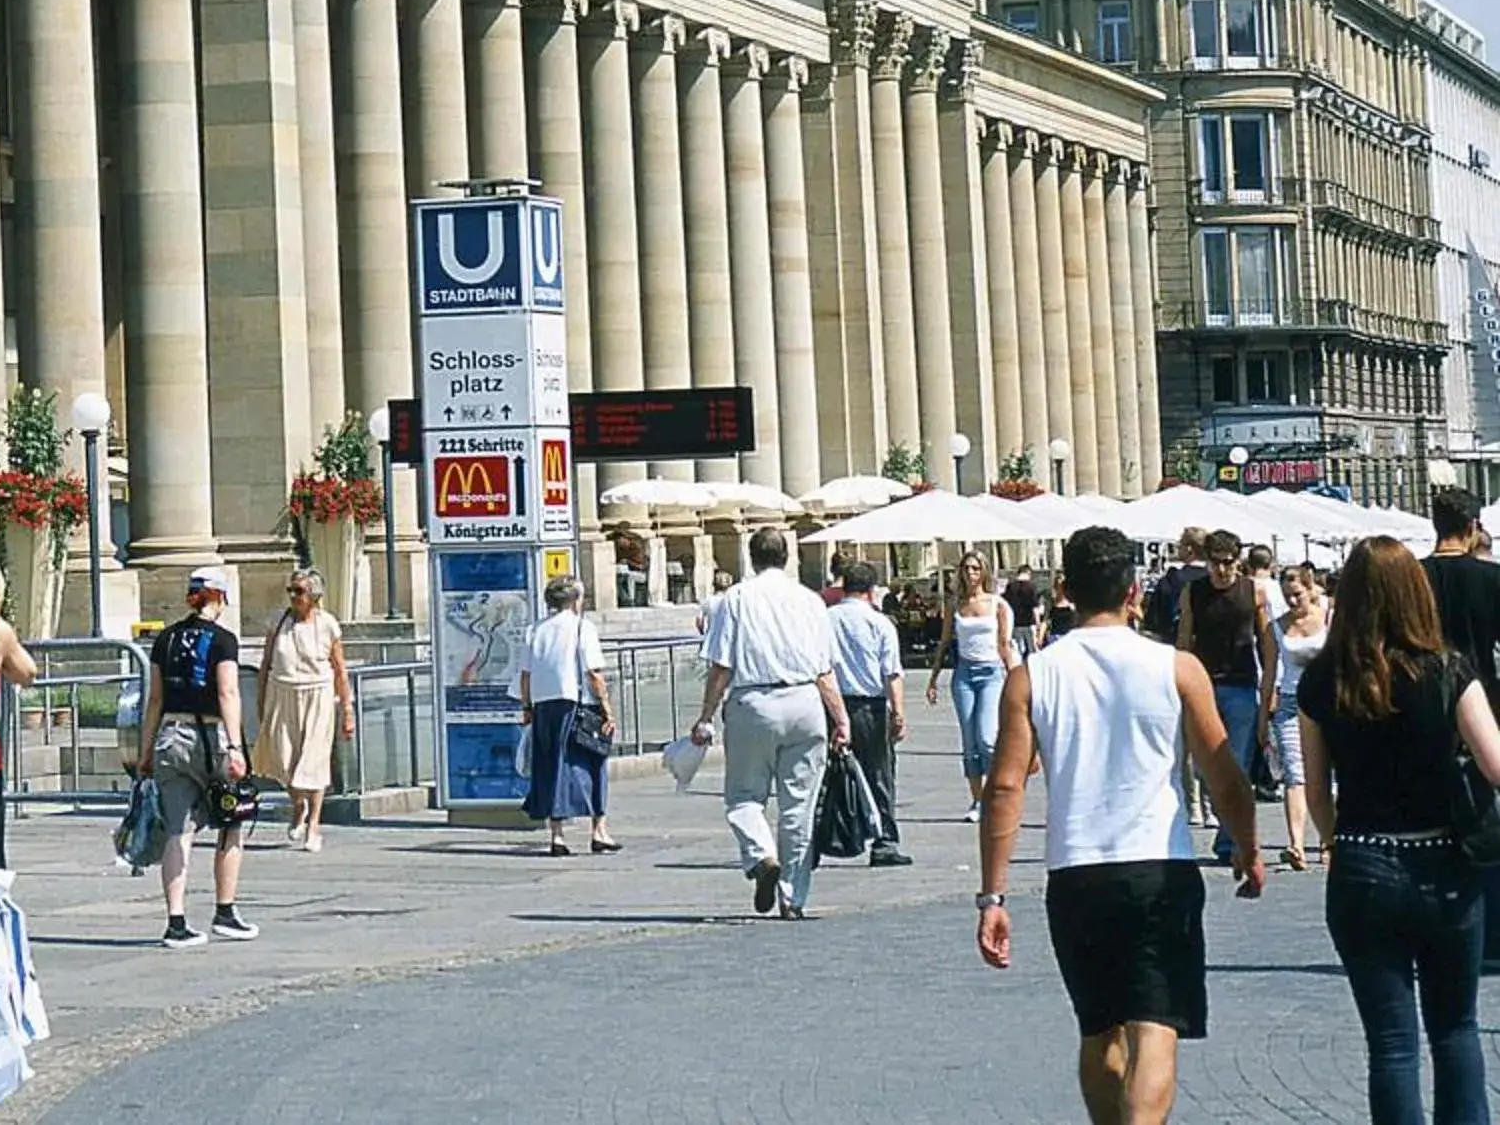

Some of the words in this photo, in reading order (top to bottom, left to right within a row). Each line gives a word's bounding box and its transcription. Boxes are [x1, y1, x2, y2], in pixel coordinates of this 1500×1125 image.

[437, 210, 505, 284] U
[534, 210, 558, 283] U
[430, 286, 517, 304] STADTBAHN
[429, 350, 523, 370] Schloss-
[450, 374, 504, 397] platz
[439, 440, 467, 453] 222
[468, 438, 524, 452] Schritte
[444, 523, 527, 542] Königstraße
